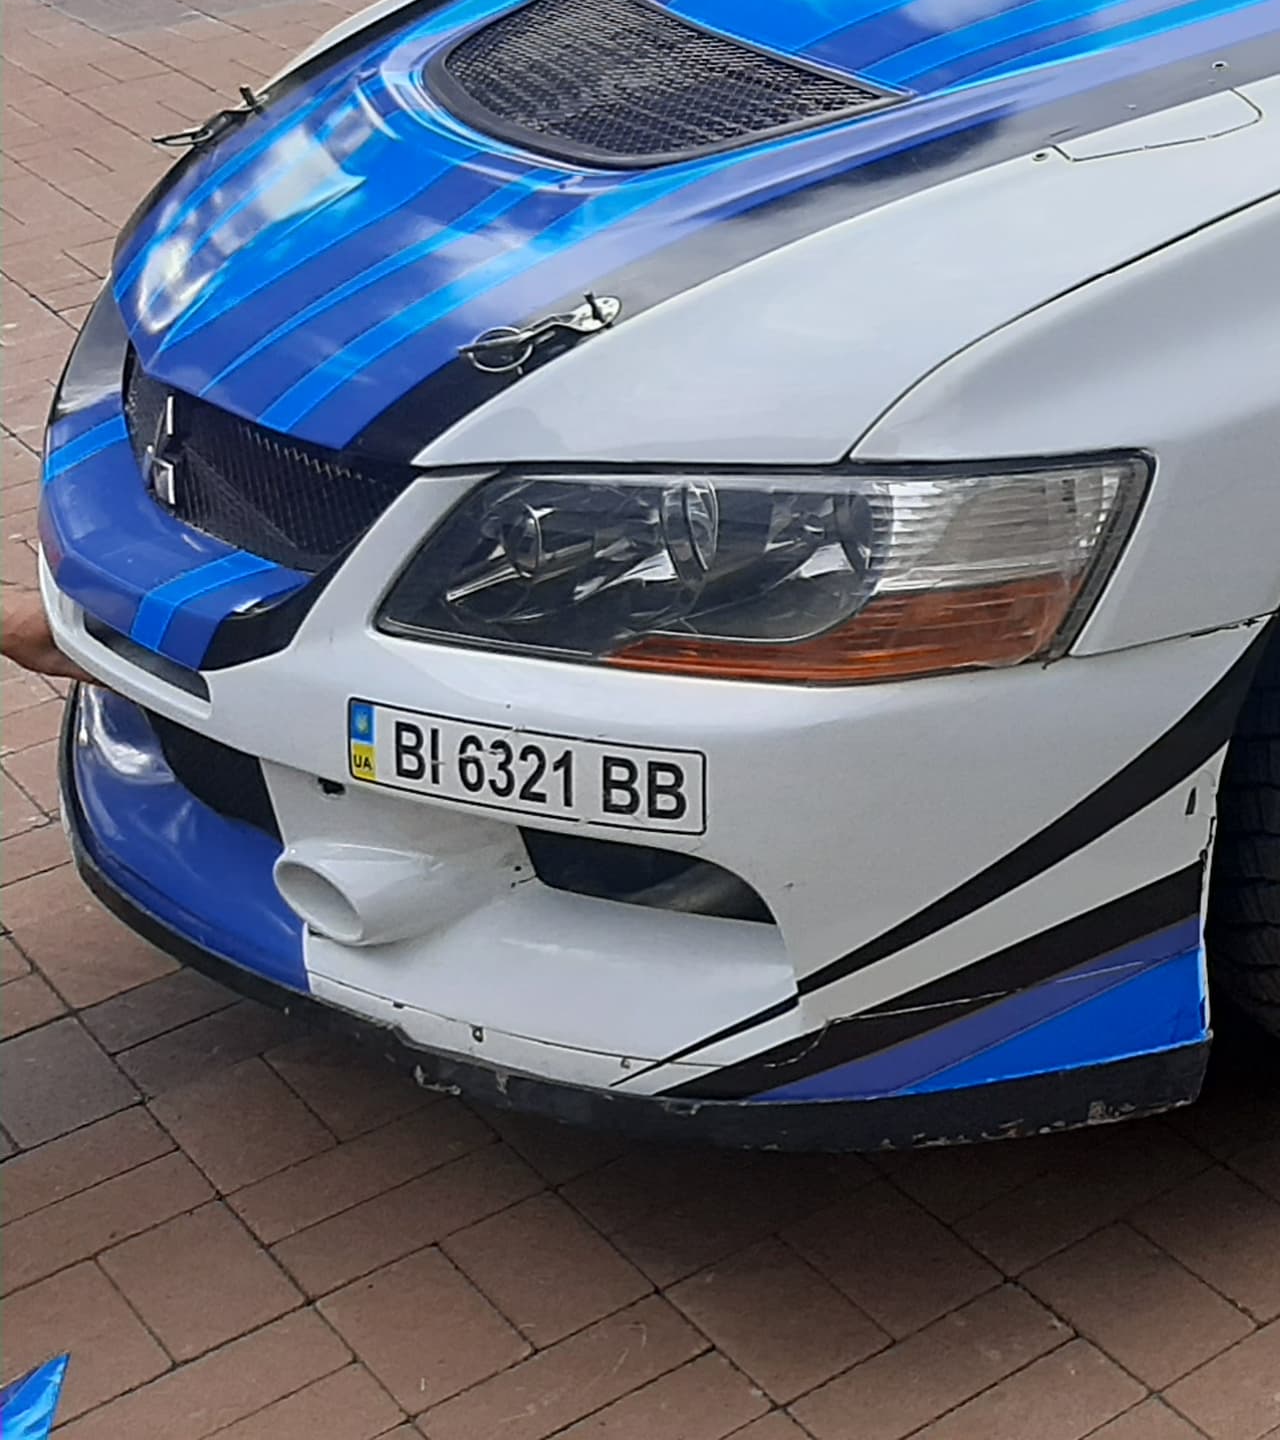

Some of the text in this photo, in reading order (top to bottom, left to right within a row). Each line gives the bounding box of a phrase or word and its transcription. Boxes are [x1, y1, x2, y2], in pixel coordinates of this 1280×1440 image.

[353, 754, 373, 772] UA
[394, 720, 687, 820] BI 6321 BB
